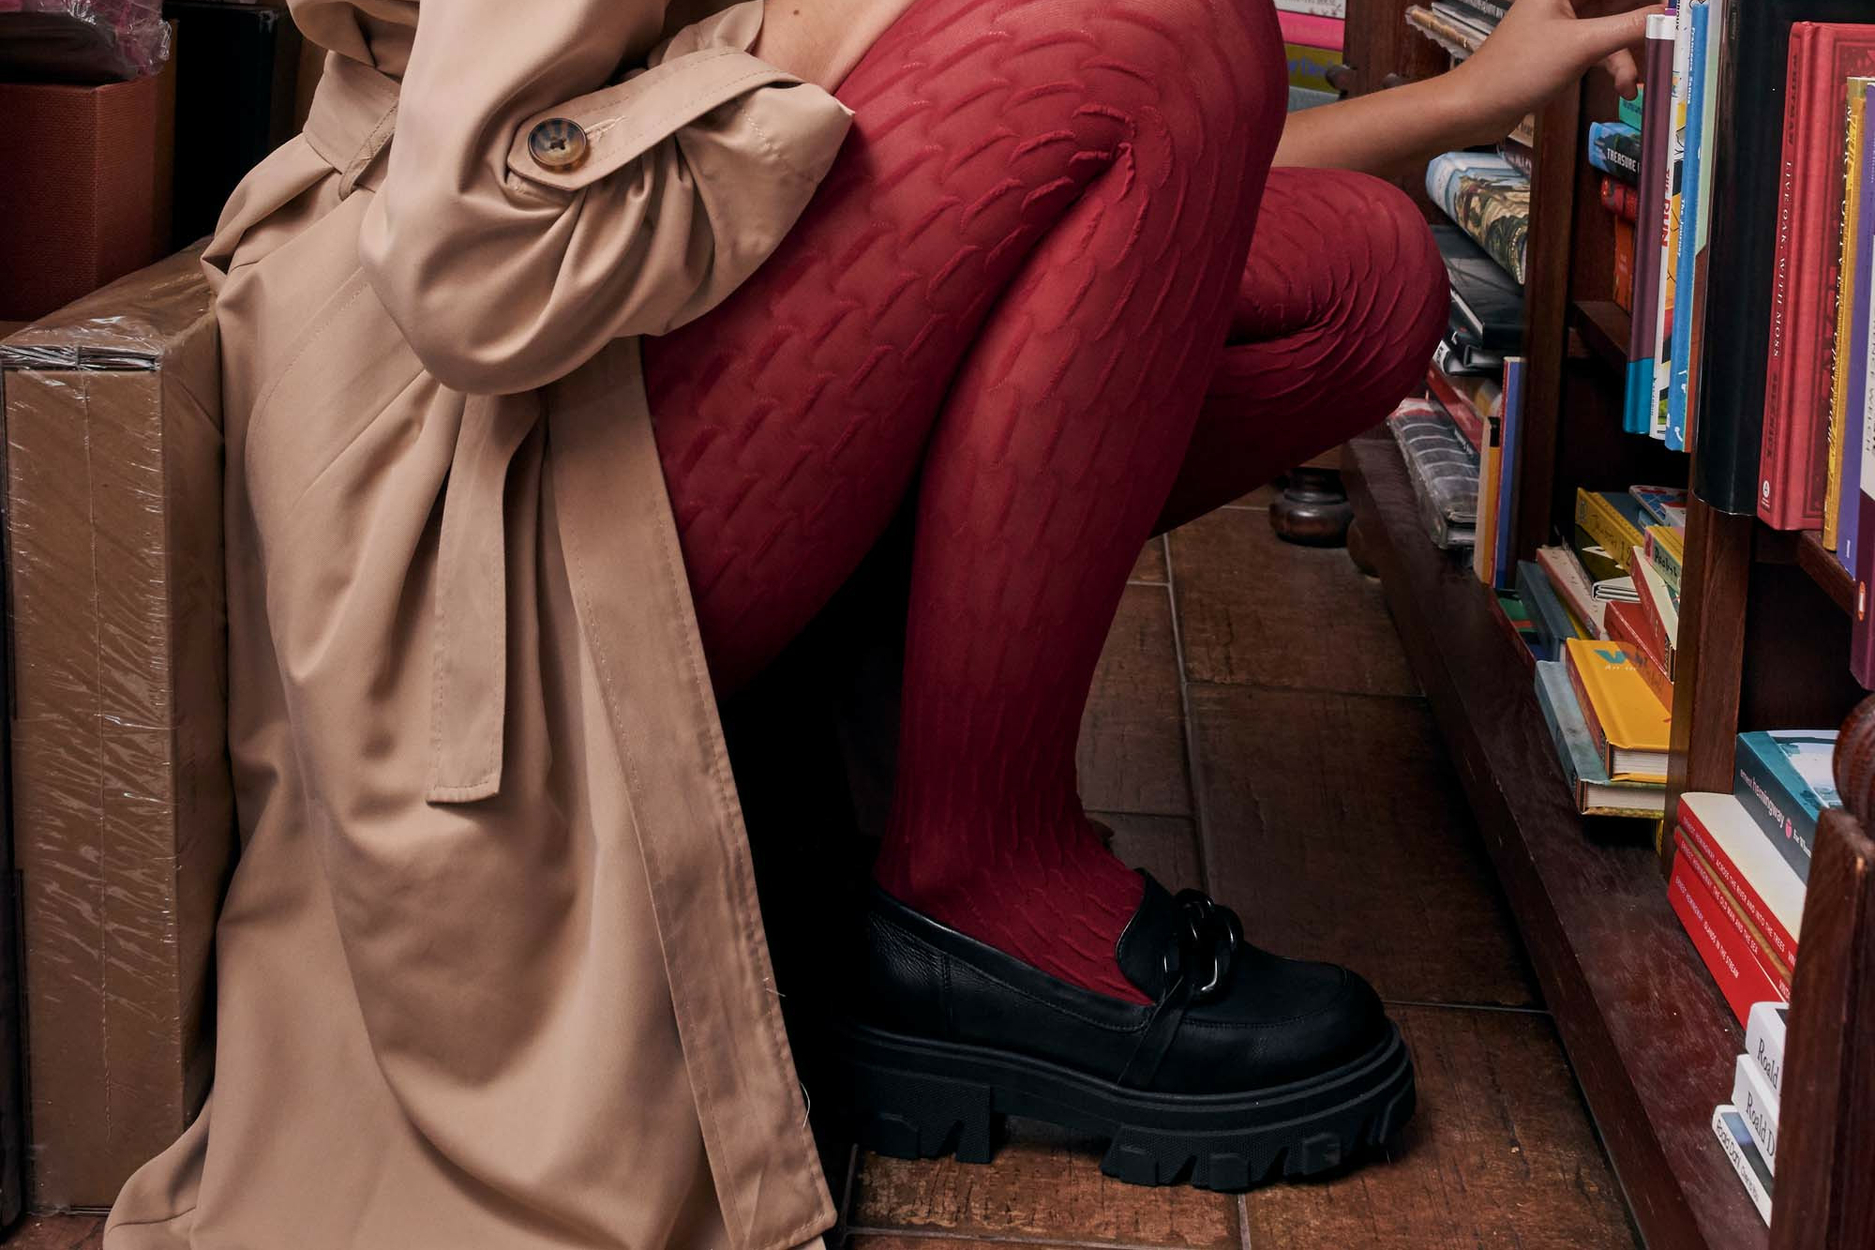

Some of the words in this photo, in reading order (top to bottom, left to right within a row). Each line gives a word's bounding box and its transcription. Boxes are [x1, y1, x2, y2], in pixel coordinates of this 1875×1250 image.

[1688, 27, 1696, 71] Francesca
[1606, 147, 1637, 173] TREASURE
[1784, 161, 1792, 202] LIVE
[1780, 209, 1789, 250] OAK,
[1777, 257, 1785, 305] WITH
[1773, 311, 1782, 357] MOSS
[1751, 776, 1785, 829] hemingway
[1713, 885, 1721, 900] THE
[1750, 941, 1759, 956] SEA
[1715, 860, 1730, 881] ACROSS
[1729, 878, 1737, 891] THE
[1735, 885, 1747, 902] RIVER
[1754, 910, 1765, 927] INTO
[1764, 922, 1774, 938] THE
[1773, 931, 1785, 952] TREES
[1703, 920, 1717, 942] ISLANDS
[1719, 945, 1727, 961] THE
[1725, 955, 1740, 979] STREAM
[1756, 1037, 1780, 1090] Roald
[1746, 1091, 1768, 1144] Roald
[1717, 1118, 1732, 1151] Roald
[1729, 1141, 1741, 1169] Dahl
